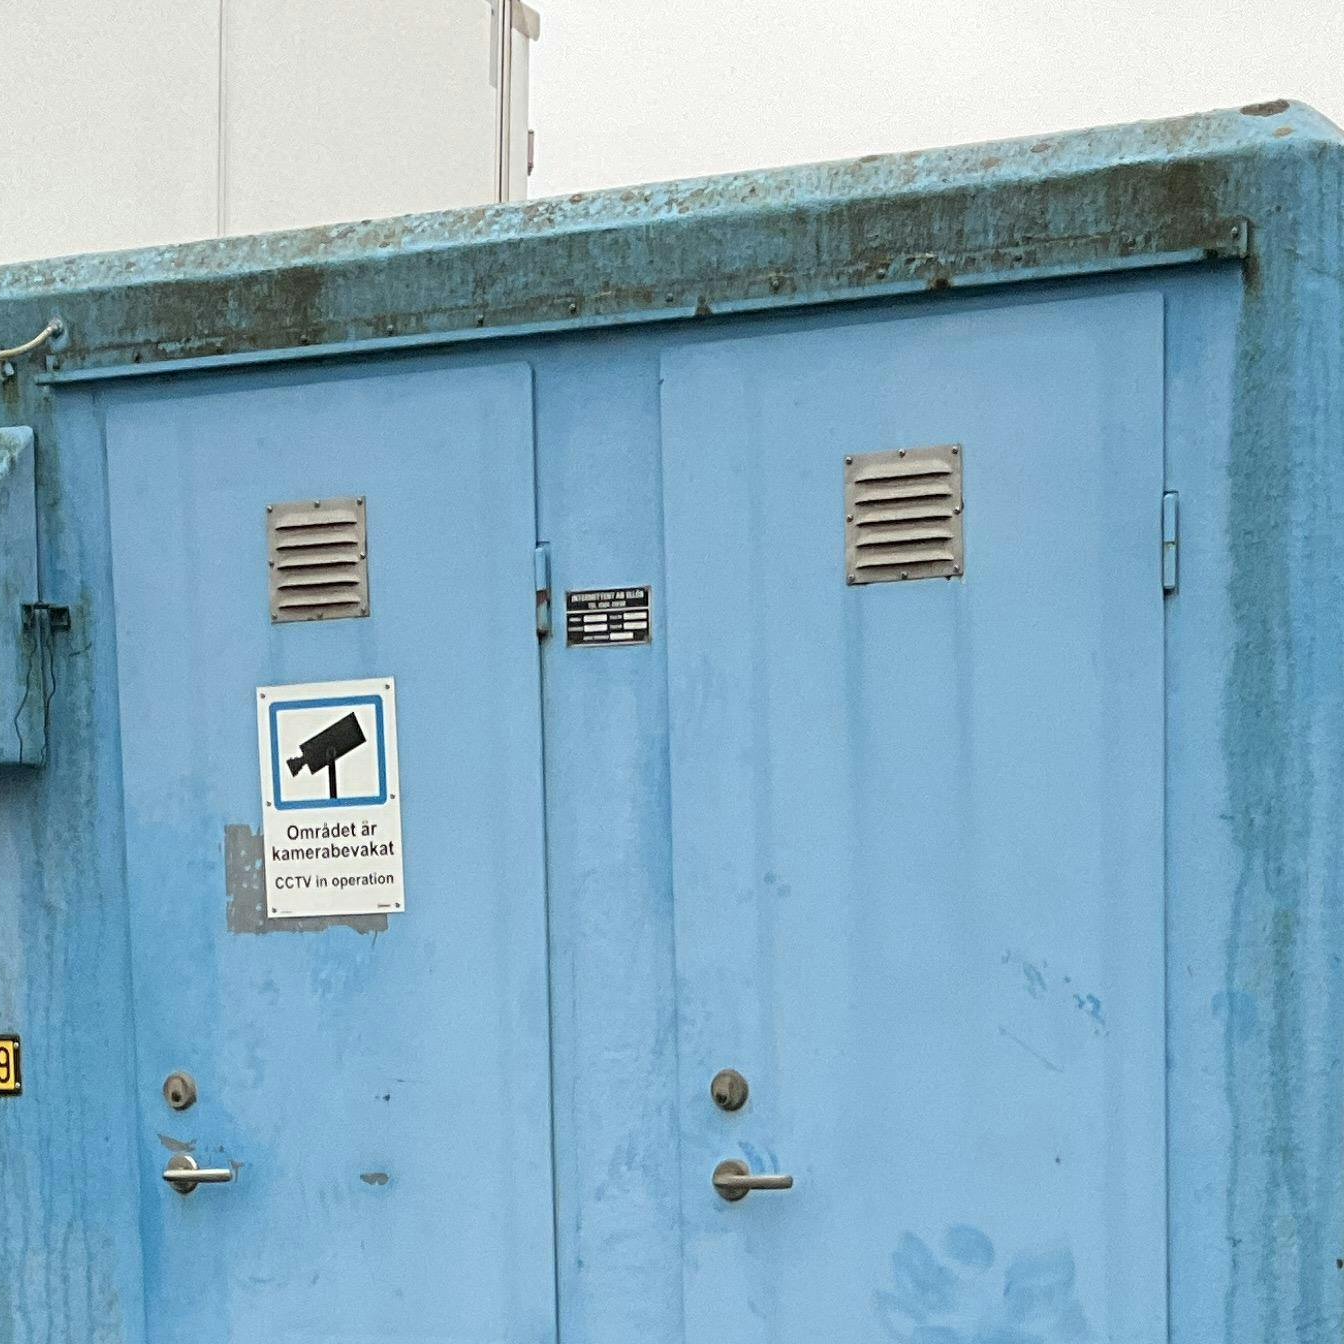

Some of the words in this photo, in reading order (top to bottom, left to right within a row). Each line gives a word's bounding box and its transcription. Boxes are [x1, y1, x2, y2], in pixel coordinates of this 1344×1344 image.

[287, 822, 356, 840] Området
[362, 820, 377, 836] är
[272, 841, 395, 861] kamerabevakat
[275, 876, 311, 889] CCTV
[316, 875, 328, 888] in
[332, 872, 394, 889] operation
